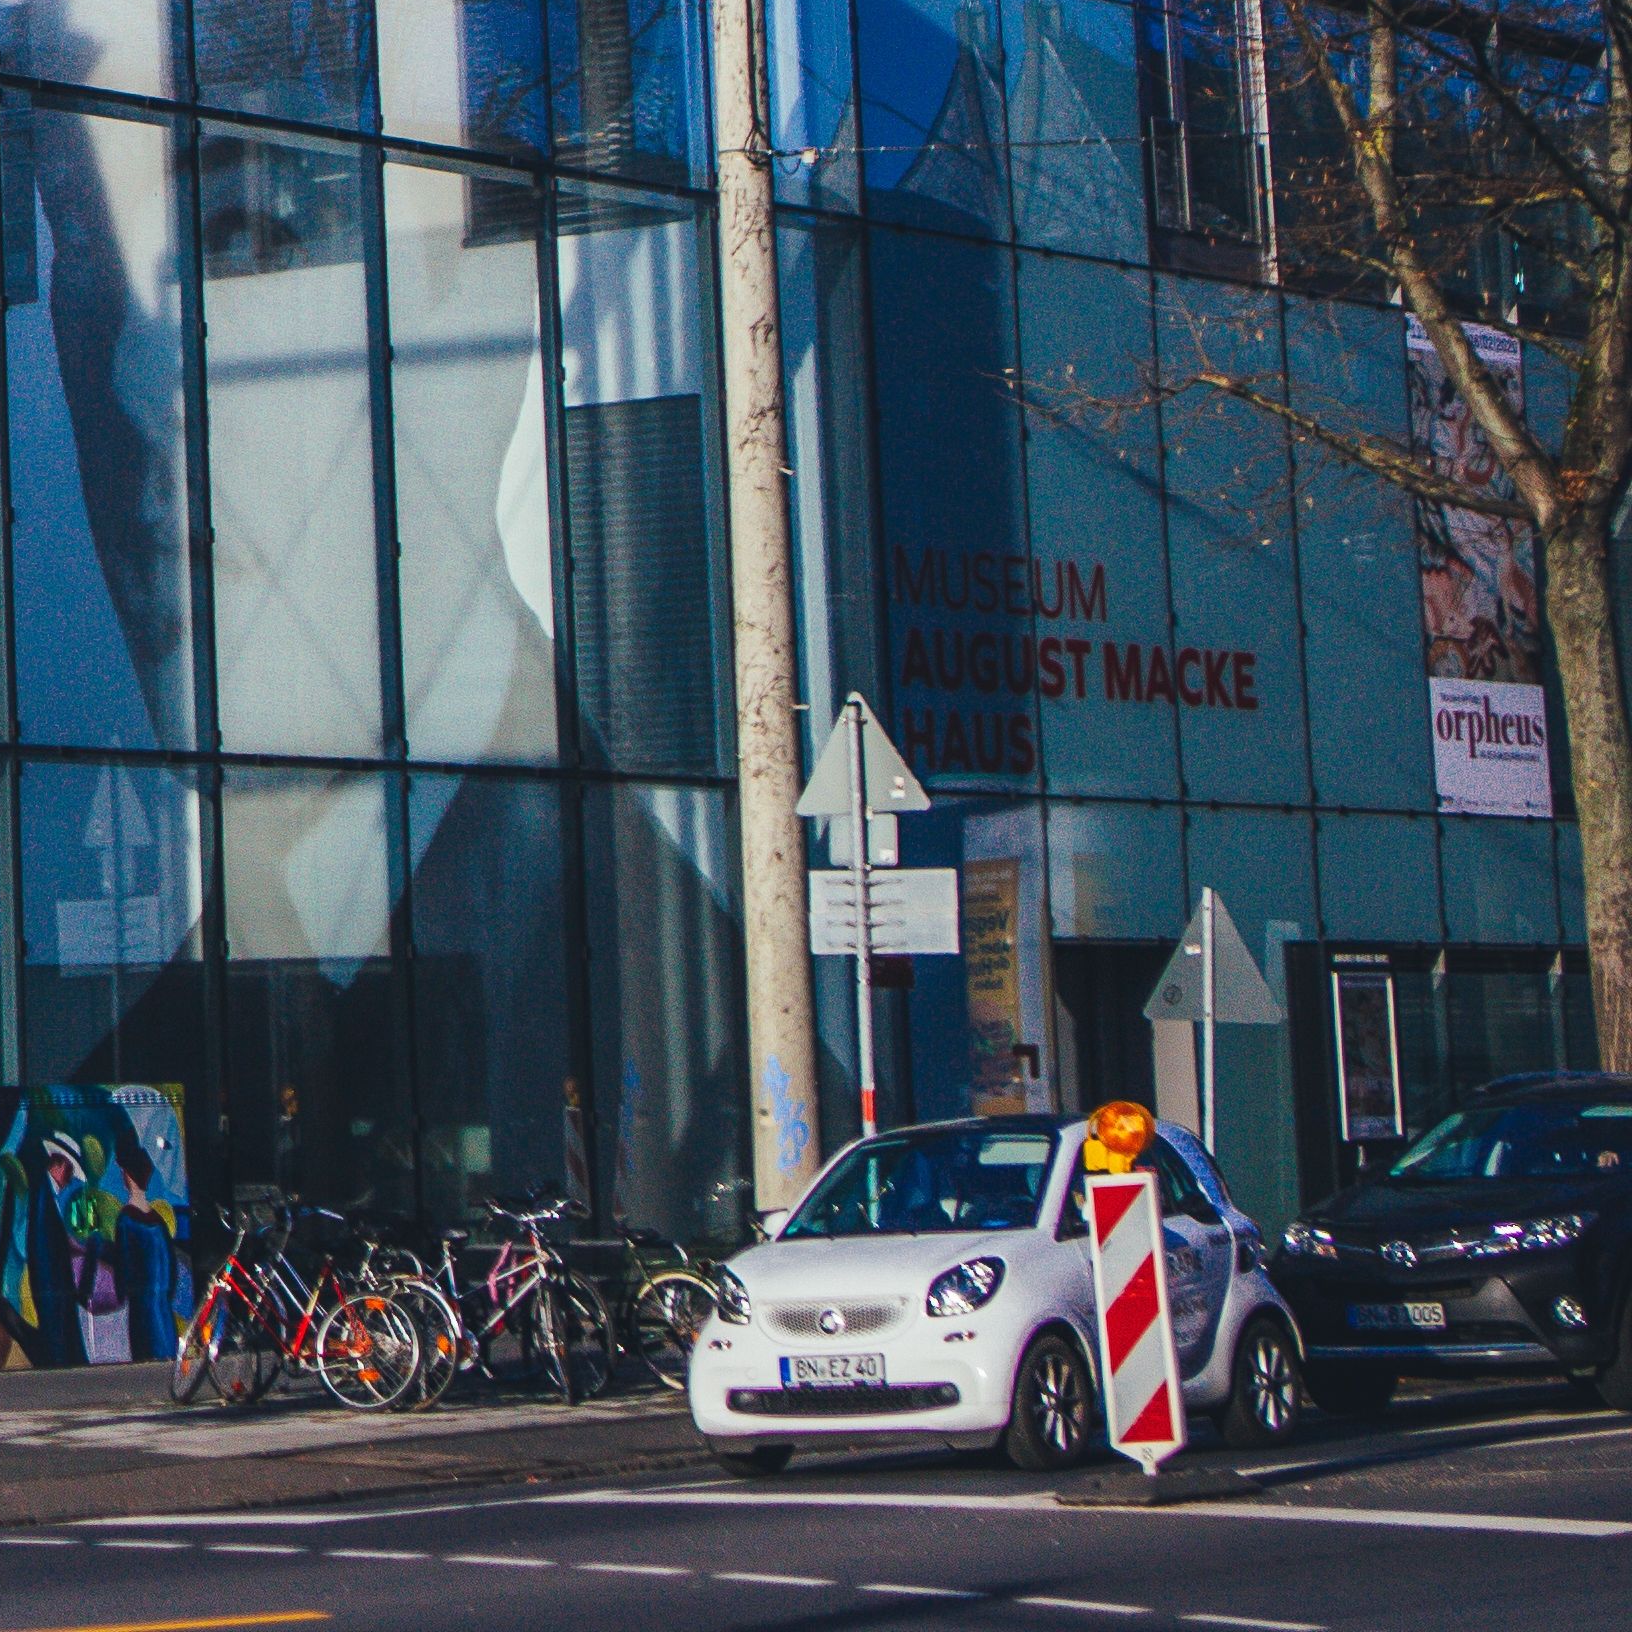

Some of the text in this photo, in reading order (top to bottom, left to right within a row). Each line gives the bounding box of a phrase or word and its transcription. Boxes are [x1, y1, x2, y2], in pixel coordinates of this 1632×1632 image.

[891, 543, 1108, 623] MUSEUM
[899, 627, 1259, 710] AUGUST MACKE
[903, 706, 1035, 773] HAUS
[1436, 694, 1544, 759] orpheus
[796, 1356, 877, 1379] BN EZ 40
